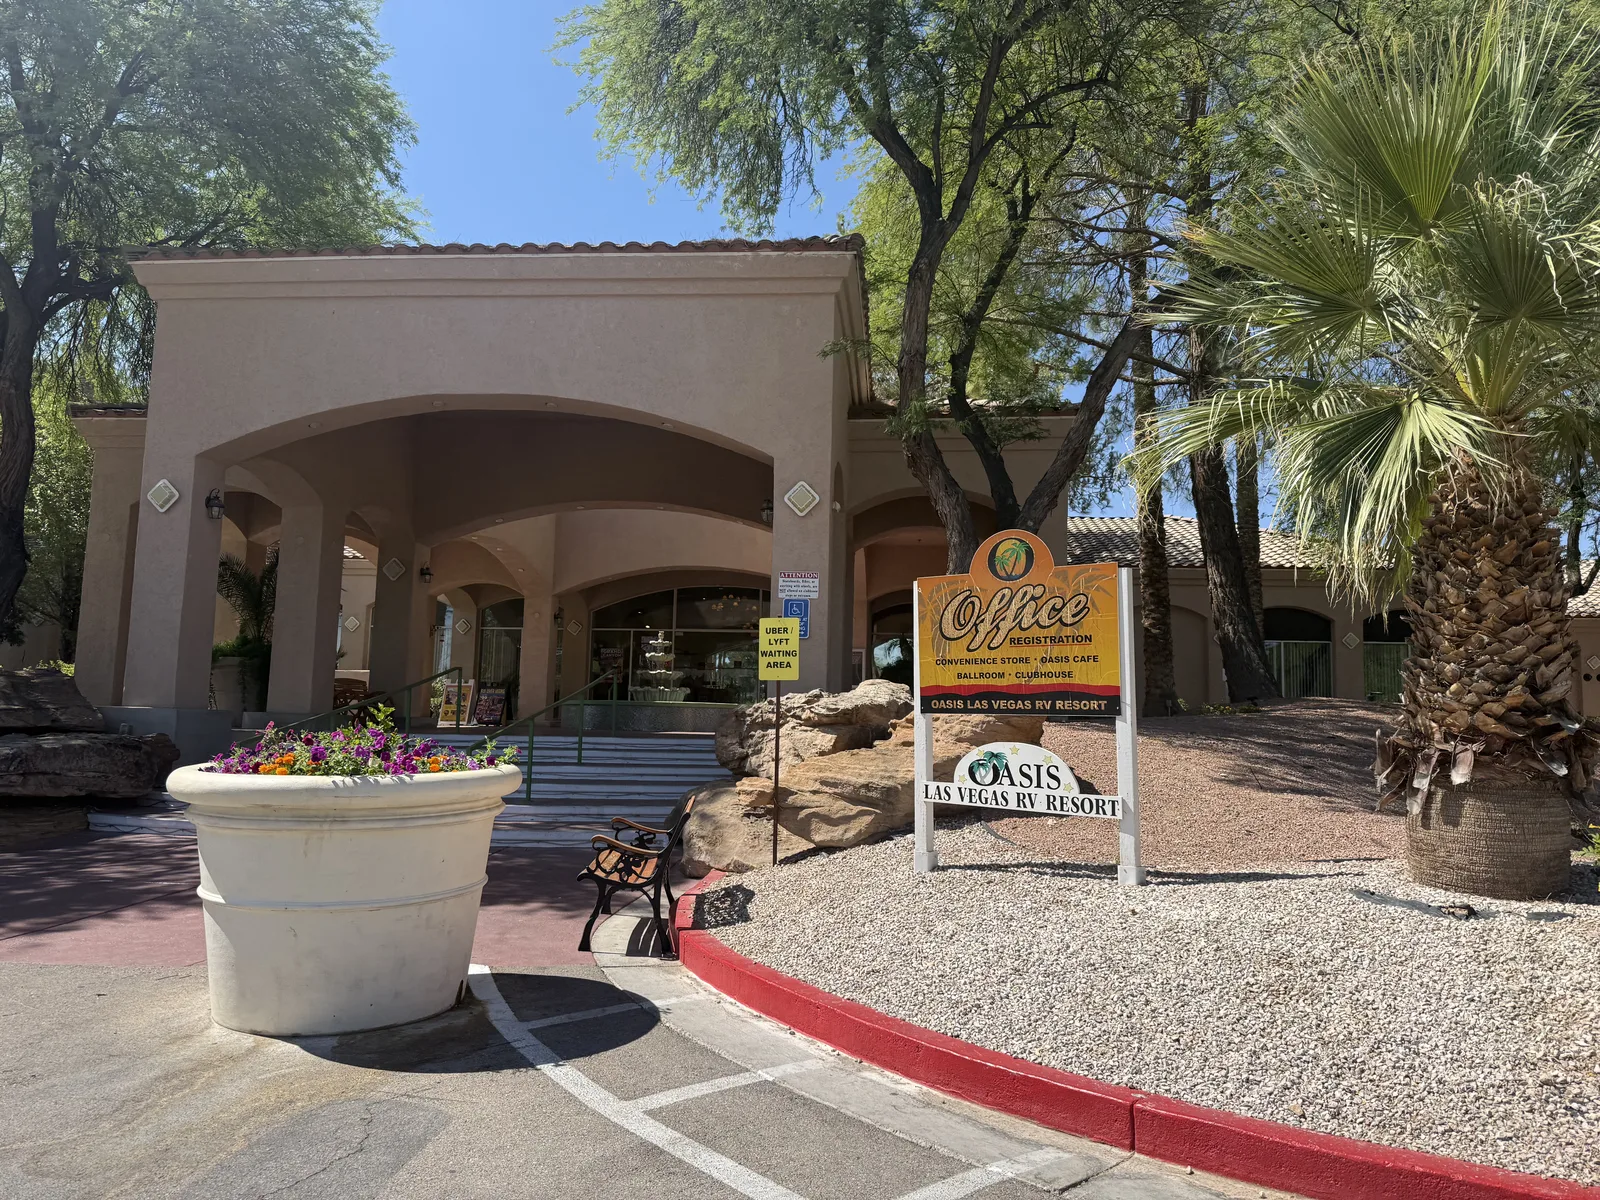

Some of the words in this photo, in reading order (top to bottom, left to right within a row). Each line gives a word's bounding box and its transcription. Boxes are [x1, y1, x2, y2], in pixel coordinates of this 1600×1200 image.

[939, 584, 1090, 652] Office
[1009, 634, 1093, 646] REGISTRATION
[935, 657, 998, 666] CONVENIENCE
[1000, 656, 1031, 665] STORE
[1041, 655, 1070, 664] OASIS
[1073, 655, 1099, 663] CAFE
[957, 671, 1005, 680] BALLROOM
[1015, 670, 1074, 679] CLUBHOUSE
[931, 699, 964, 709] OASIS
[967, 699, 989, 709] LAS
[991, 700, 1032, 710] VEGAS
[1035, 700, 1052, 710] RV
[1055, 700, 1107, 711] RESORT
[967, 758, 1061, 790] OASIS
[924, 784, 951, 801] LAS
[957, 787, 1009, 807] VEGAS
[1016, 792, 1038, 809] RV
[1045, 794, 1119, 817] RESORT
